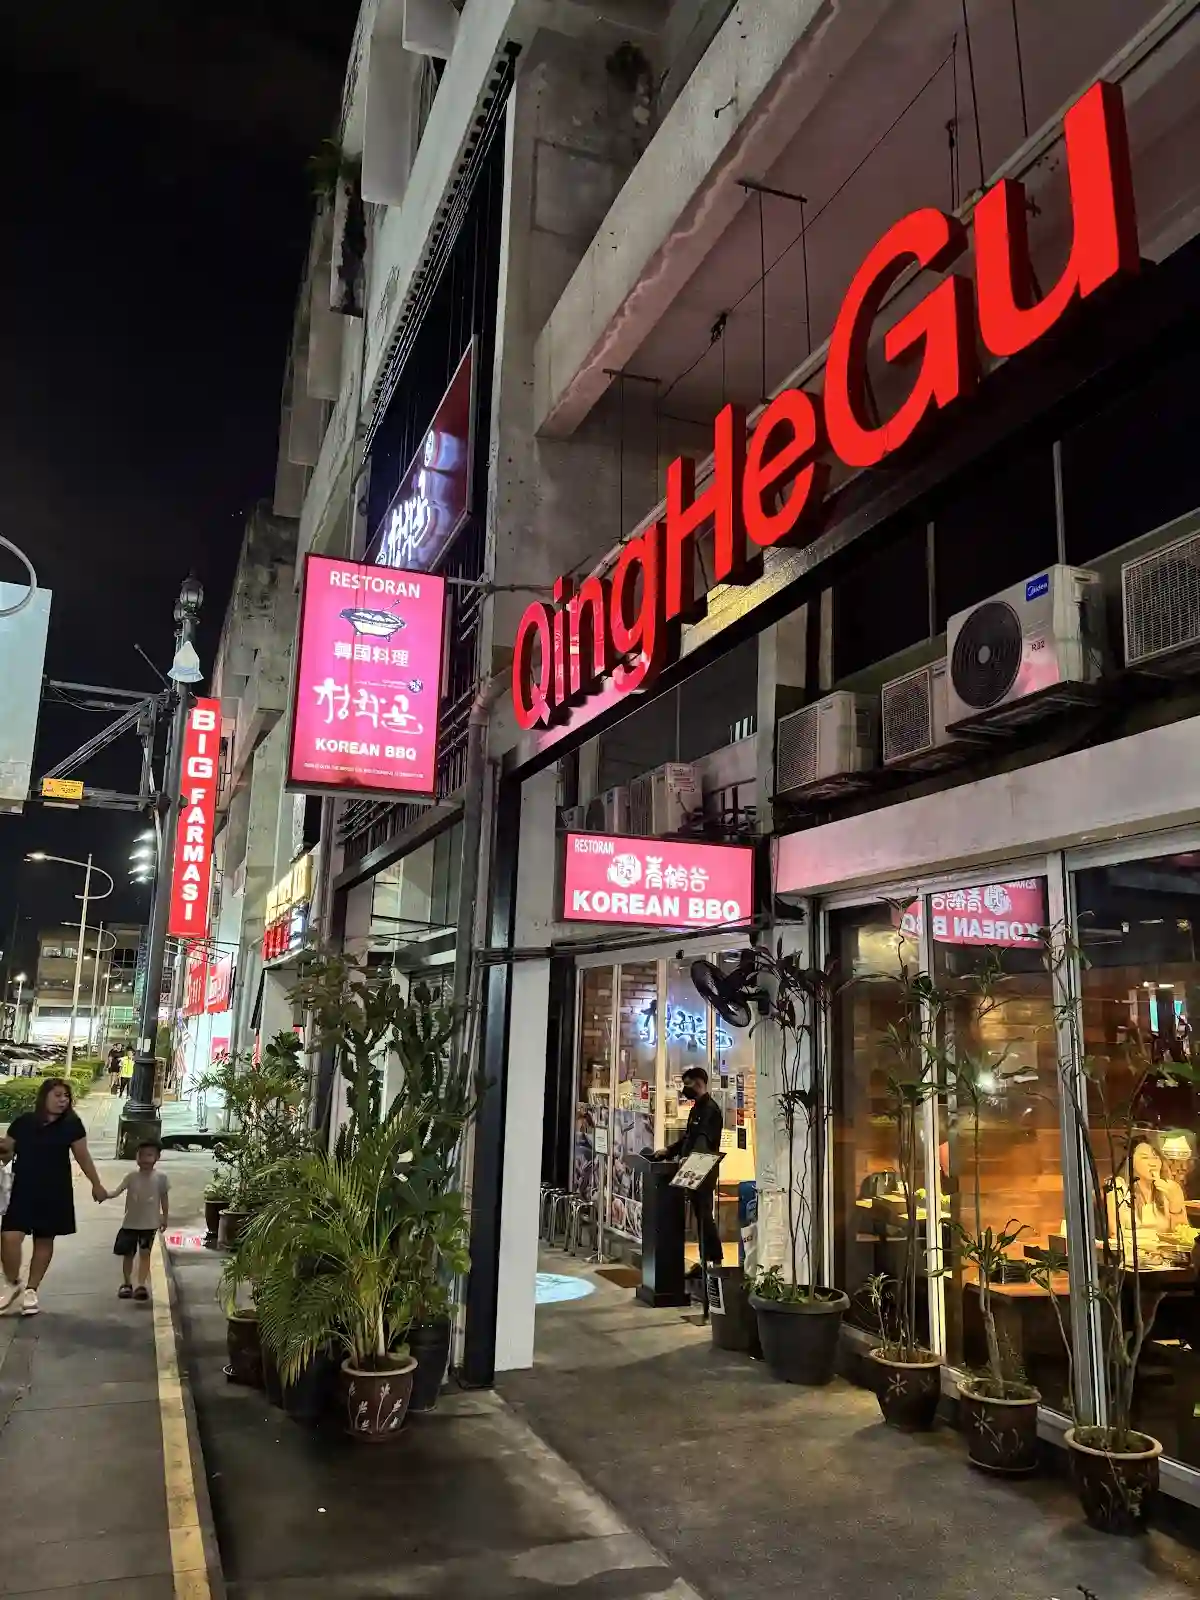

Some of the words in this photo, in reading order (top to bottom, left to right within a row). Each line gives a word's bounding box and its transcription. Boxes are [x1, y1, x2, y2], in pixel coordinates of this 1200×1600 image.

[511, 80, 1130, 732] QingHeGu
[329, 570, 421, 599] RESTORAN
[1031, 640, 1045, 652] R32
[187, 709, 216, 778] BIG
[315, 737, 380, 758] KOREAN
[384, 745, 418, 760] BBQ
[181, 787, 206, 921] FARMASI
[574, 838, 615, 855] RESTORAN
[572, 889, 680, 918] KOREAN
[687, 897, 741, 921] BBQ
